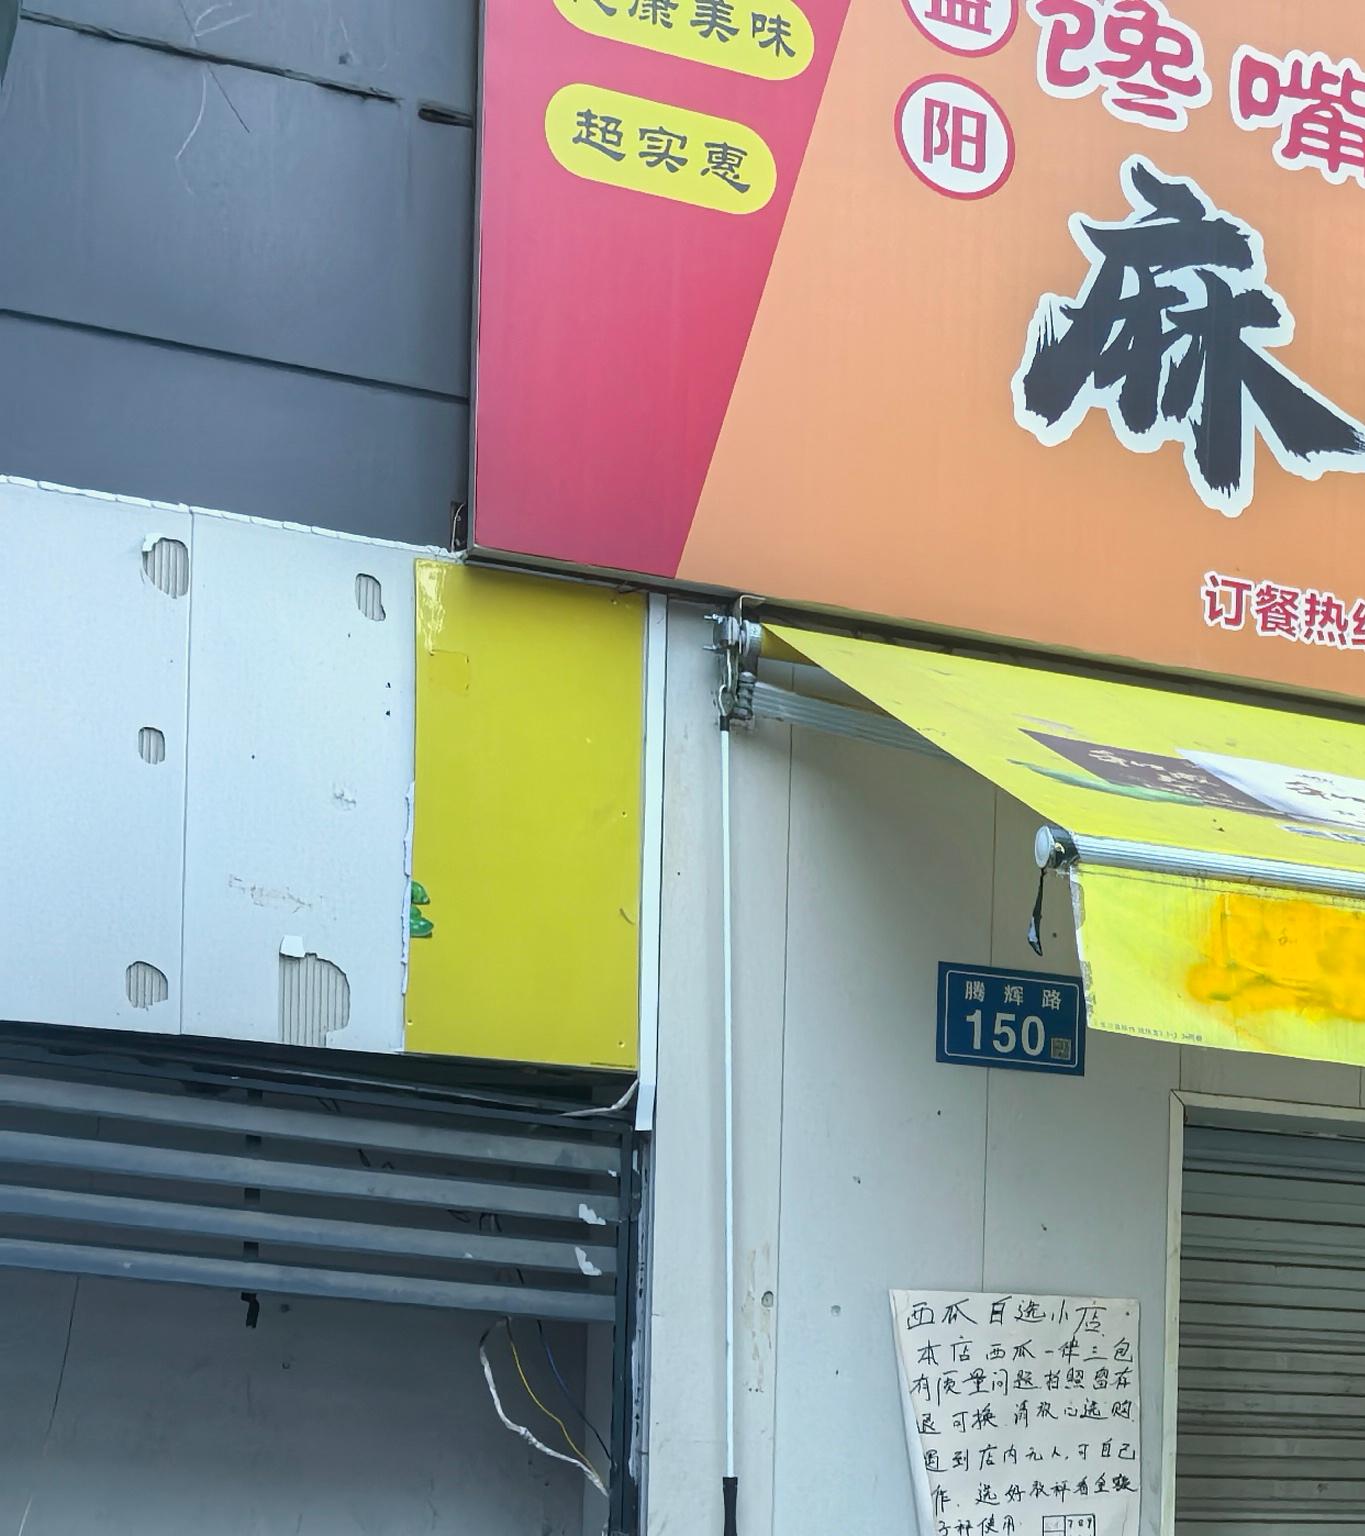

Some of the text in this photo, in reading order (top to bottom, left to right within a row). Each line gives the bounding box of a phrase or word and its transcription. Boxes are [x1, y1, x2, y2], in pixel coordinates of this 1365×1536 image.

[573, 0, 797, 58] 康美味
[571, 108, 750, 194] 超实惠
[964, 980, 1062, 1011] 腾辉路
[966, 1009, 1046, 1057] 150
